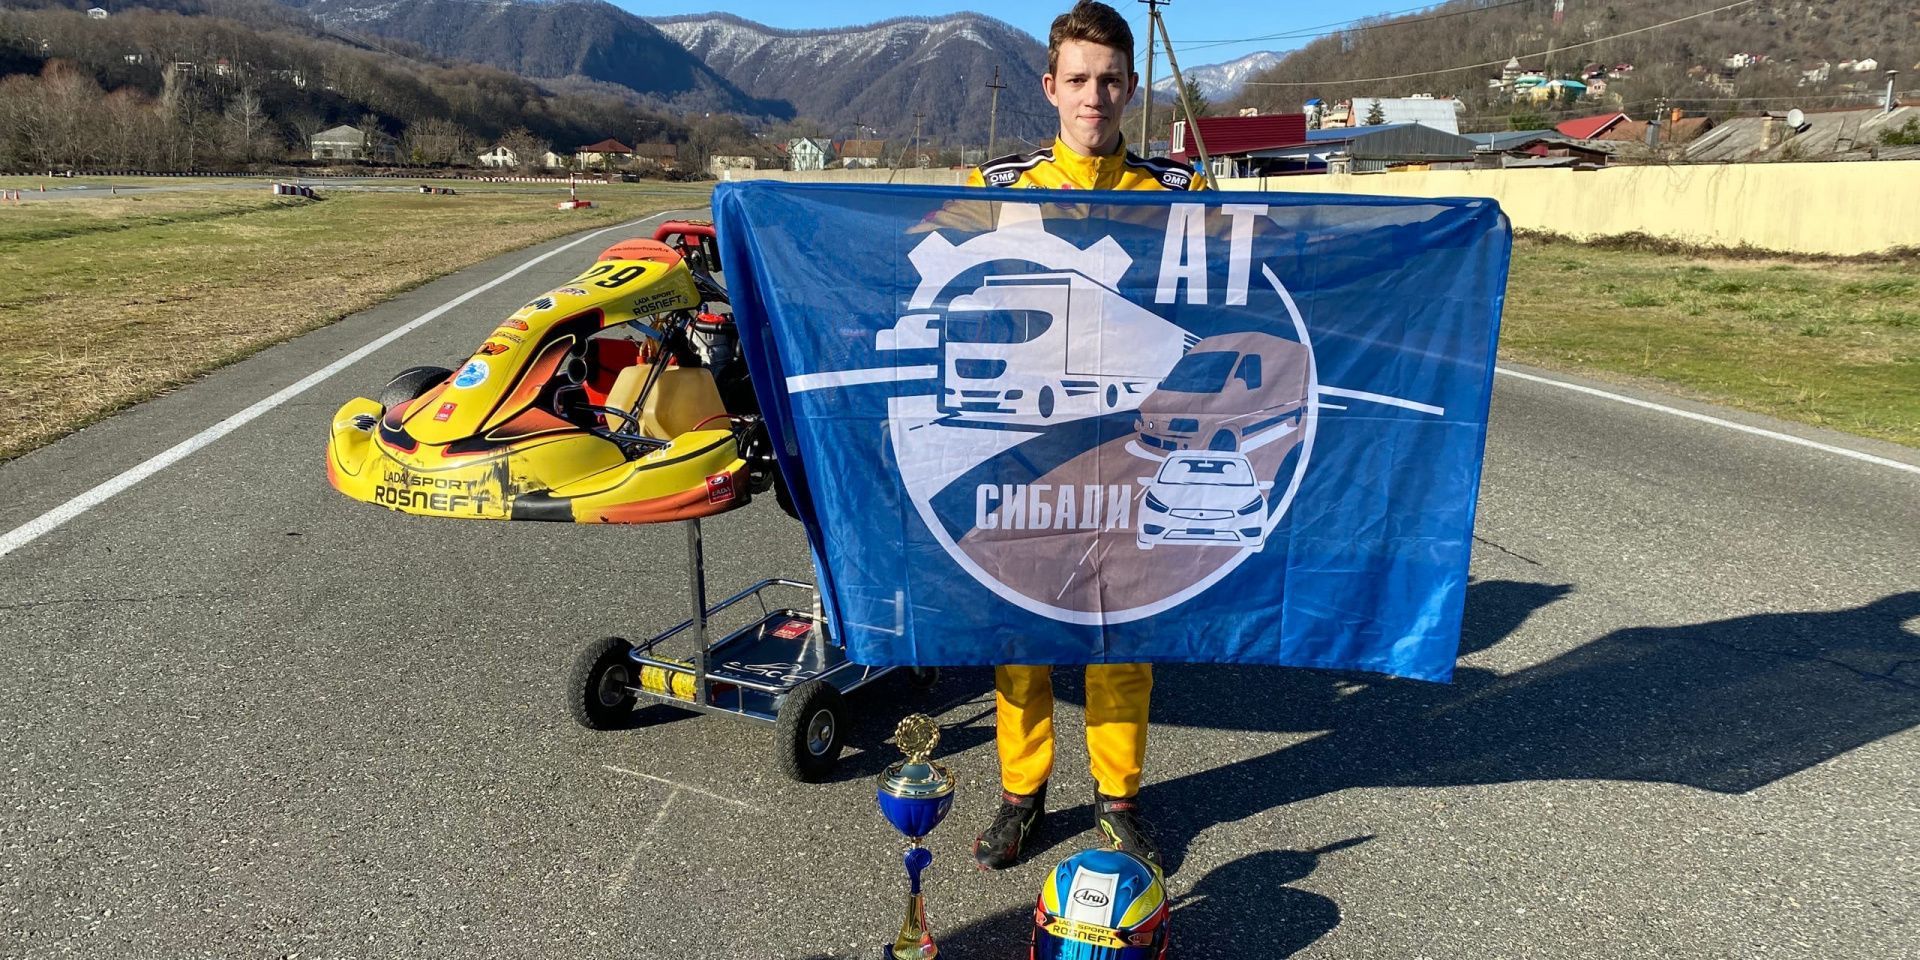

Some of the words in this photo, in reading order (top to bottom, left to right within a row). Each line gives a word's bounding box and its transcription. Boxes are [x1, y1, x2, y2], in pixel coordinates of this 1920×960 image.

[990, 172, 1015, 183] OMP
[1163, 174, 1188, 186] OMP
[1154, 202, 1269, 306] АТ
[651, 290, 675, 301] SPORT
[633, 294, 682, 316] ROSNEFT
[383, 470, 407, 484] LADA
[411, 476, 477, 490] SPORT
[375, 485, 490, 514] ROSNEFT
[975, 483, 1132, 530] СИБАДИ
[1075, 890, 1104, 904] Arai
[1077, 924, 1112, 935] SPORT
